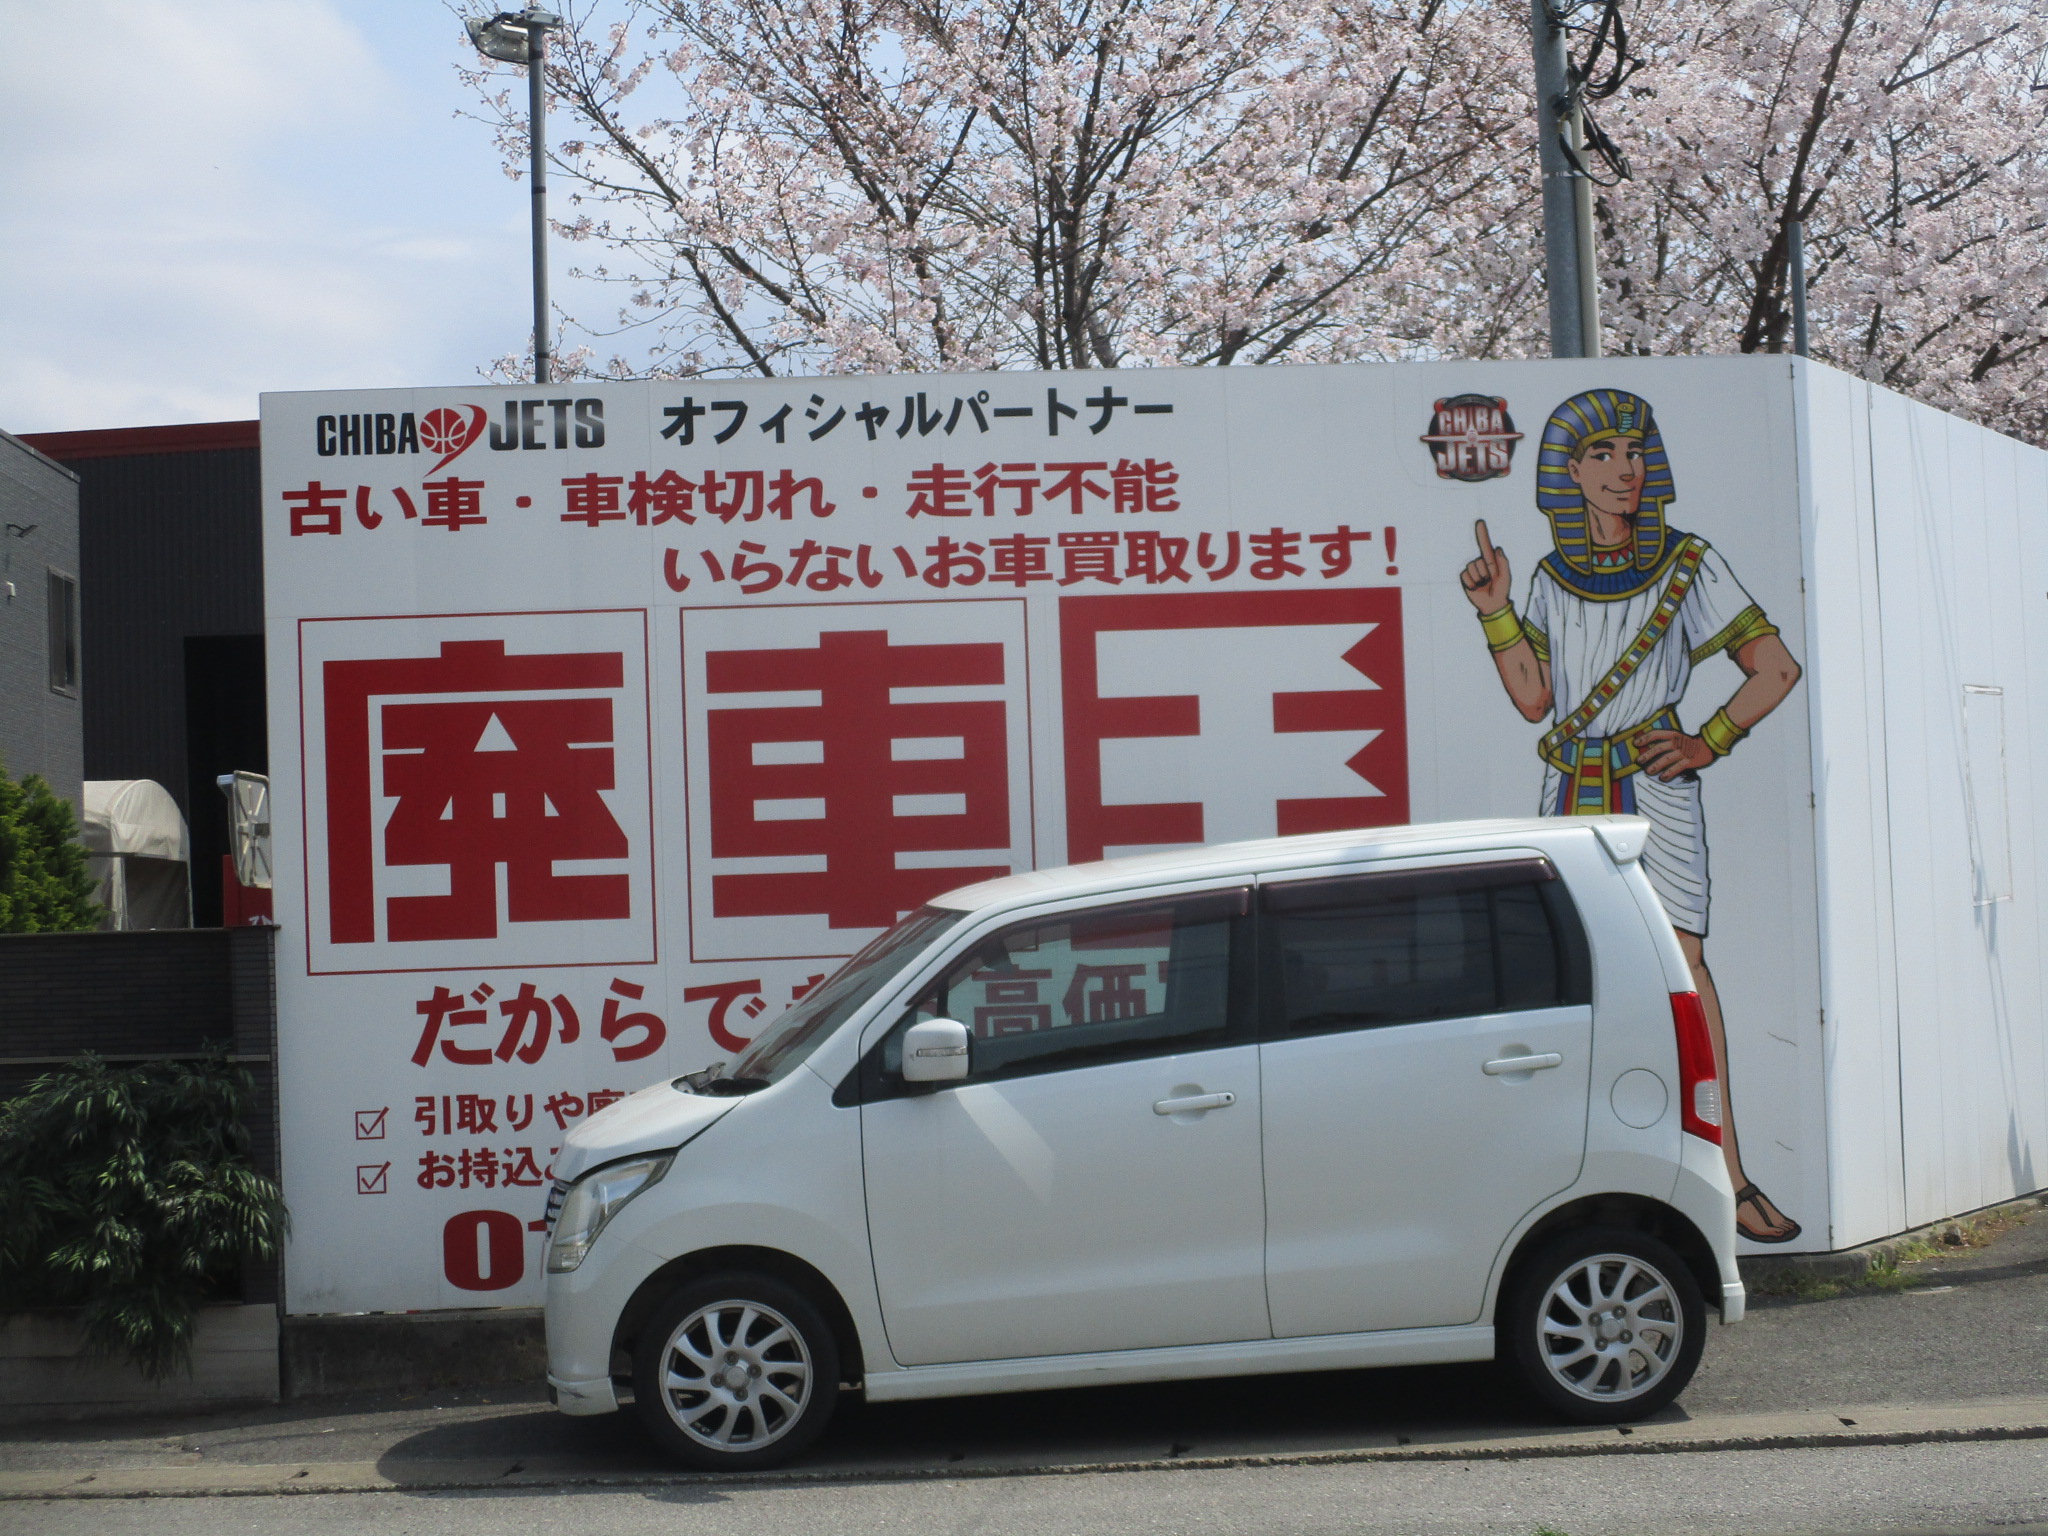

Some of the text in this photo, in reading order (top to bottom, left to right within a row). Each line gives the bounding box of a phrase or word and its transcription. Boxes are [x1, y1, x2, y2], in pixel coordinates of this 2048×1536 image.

[317, 398, 605, 457] CHIBA JETS
[660, 386, 1174, 446] オフィシャルパートナー
[1437, 440, 1509, 473] JETS
[411, 962, 1170, 1068] だからで 高価
[414, 1089, 643, 1136] 引取りや
[416, 1147, 559, 1190] お持込
